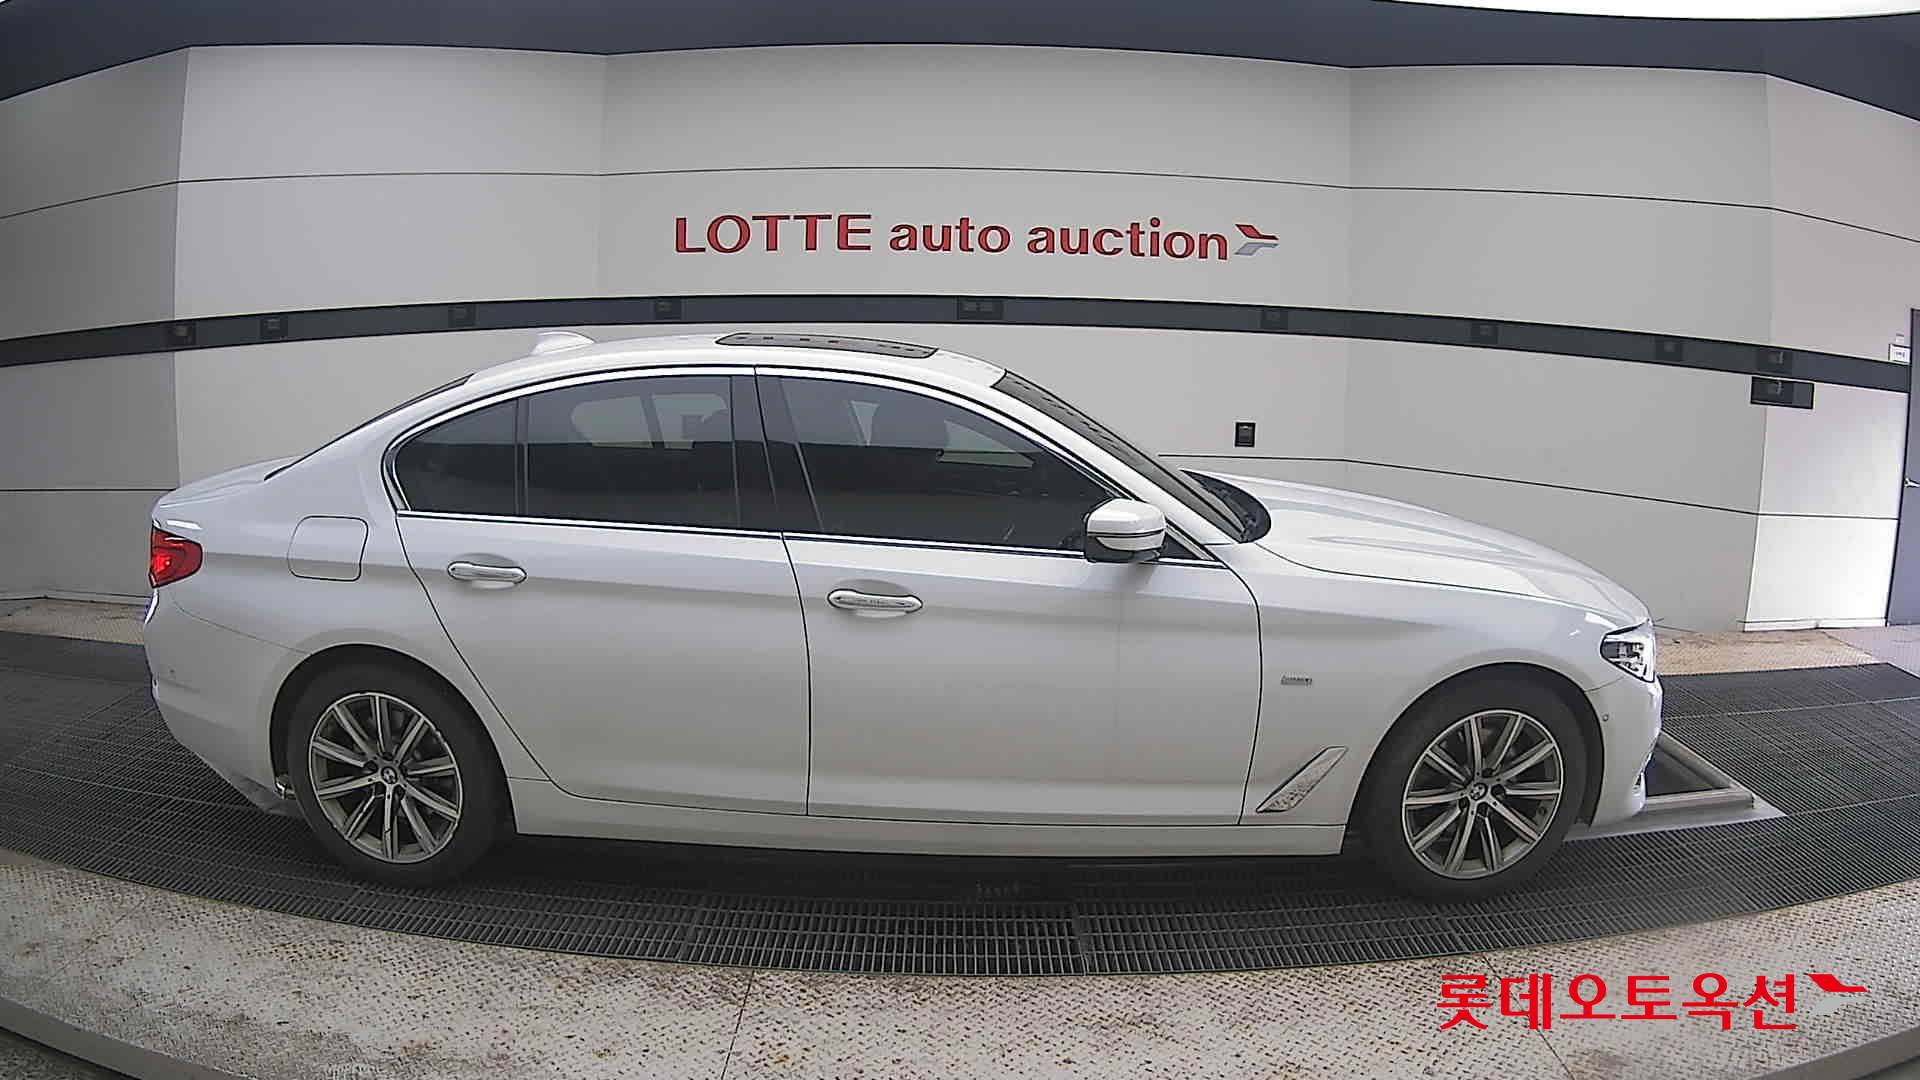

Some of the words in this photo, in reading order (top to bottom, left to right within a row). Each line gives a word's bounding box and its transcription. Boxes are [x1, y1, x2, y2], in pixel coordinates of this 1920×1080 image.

[674, 214, 872, 254] LOTTE
[889, 218, 1011, 252] auto
[1027, 217, 1228, 260] auction
